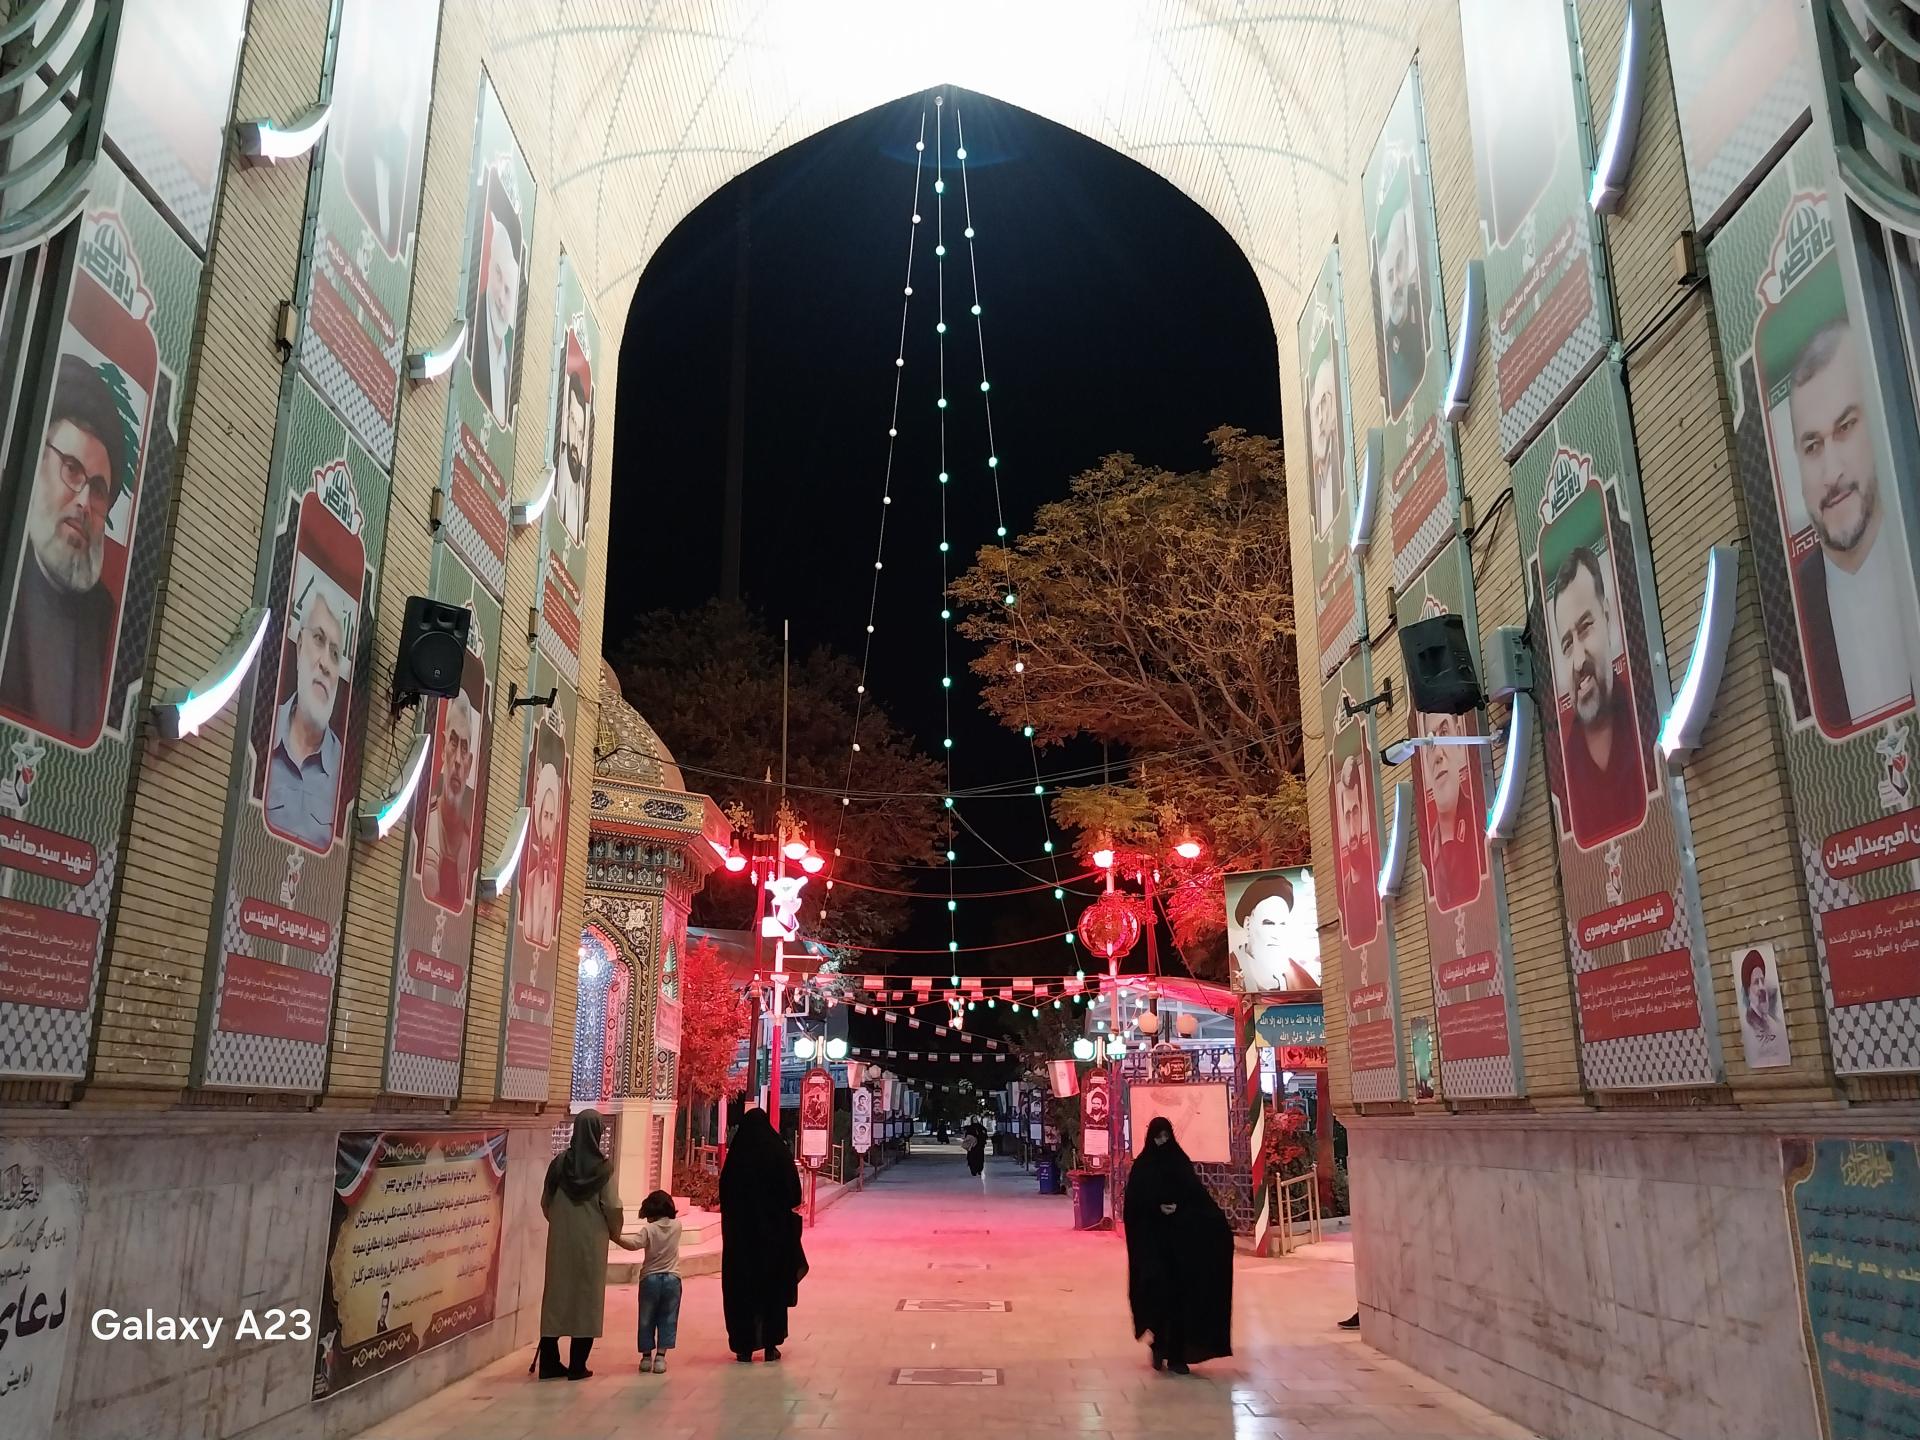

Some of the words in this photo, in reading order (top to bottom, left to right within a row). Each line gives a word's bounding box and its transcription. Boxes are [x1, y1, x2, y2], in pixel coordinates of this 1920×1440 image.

[35, 843, 60, 865] سید
[61, 850, 92, 875] شهید
[243, 910, 280, 931] المهندس
[1626, 910, 1644, 930] سید
[1642, 899, 1664, 925] شهید
[1584, 919, 1610, 943] موسوی
[1610, 913, 1628, 935] رضی
[308, 925, 326, 946] شهید
